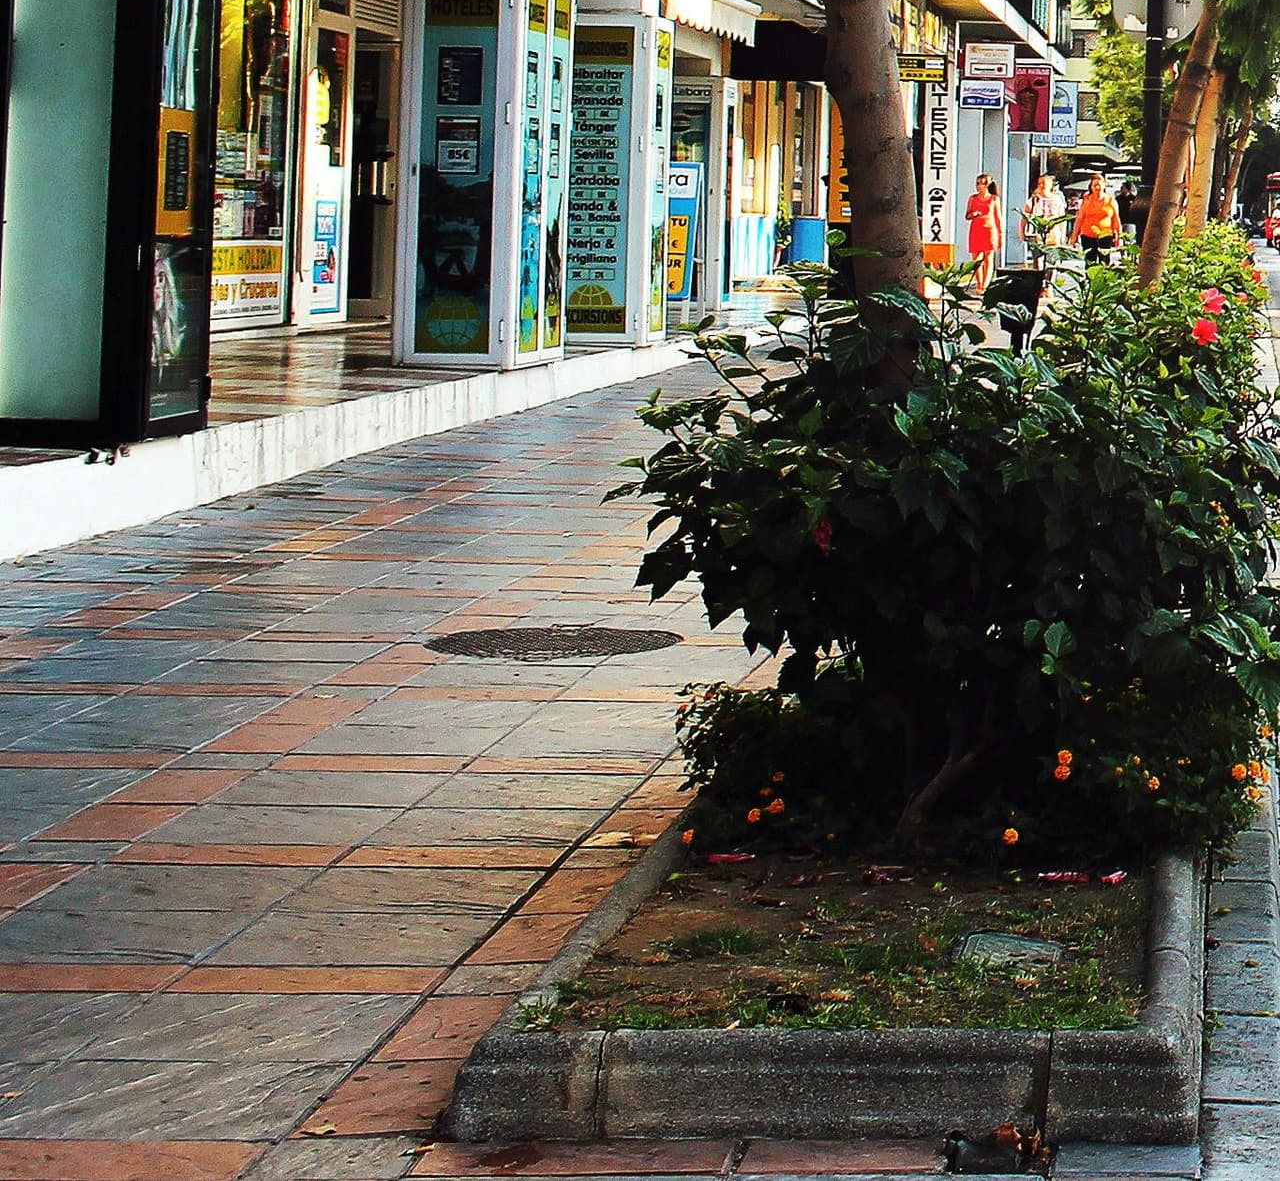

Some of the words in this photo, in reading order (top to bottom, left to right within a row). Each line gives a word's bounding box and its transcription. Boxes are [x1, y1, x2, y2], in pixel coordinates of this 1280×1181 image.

[930, 83, 948, 181] NTERNET
[1051, 134, 1074, 144] ESTATE
[447, 149, 470, 159] 85€
[575, 149, 615, 160] Sevilla
[608, 201, 617, 211] &
[930, 204, 943, 242] FAX
[568, 238, 601, 250] Nerja
[605, 239, 615, 249] &
